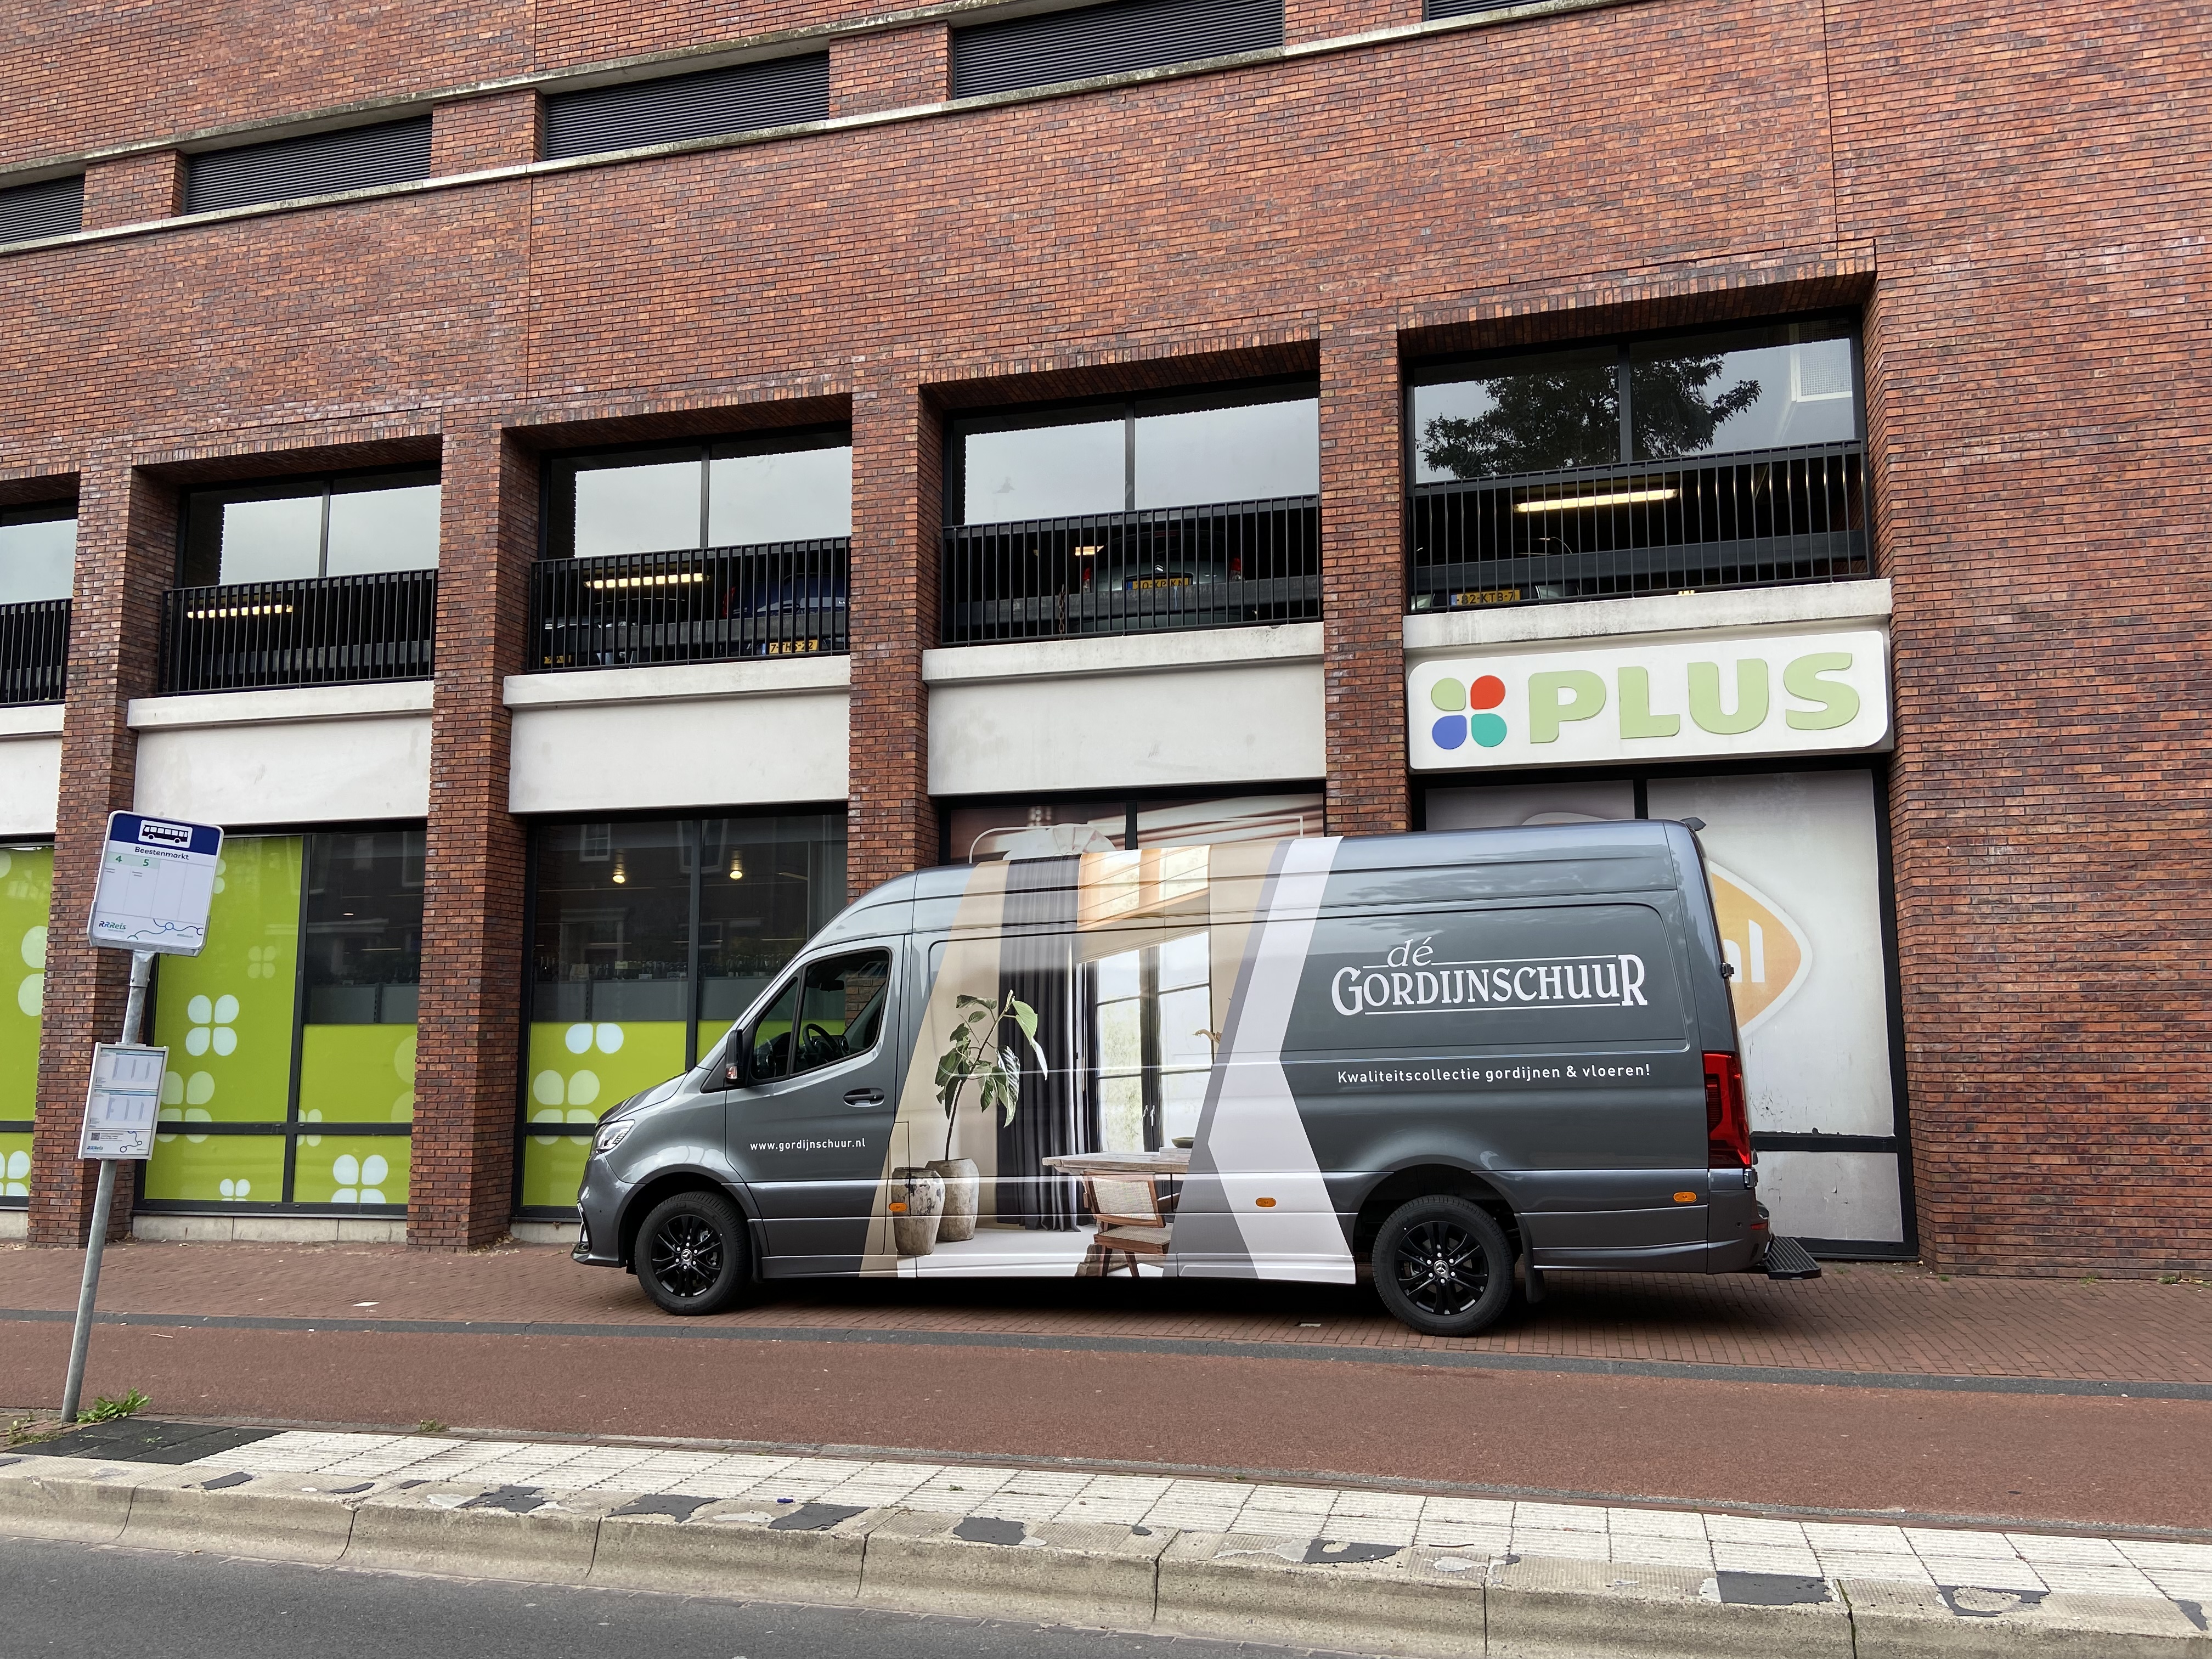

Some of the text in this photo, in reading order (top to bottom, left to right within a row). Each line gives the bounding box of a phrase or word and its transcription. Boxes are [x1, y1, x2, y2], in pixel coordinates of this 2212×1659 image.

[1528, 652, 1860, 743] PLUS
[135, 847, 189, 860] Beestenmarkt
[99, 921, 127, 930] RRReis
[1387, 937, 1434, 967] dé
[1331, 954, 1648, 1016] GORDIJNSCHUUR
[1338, 1063, 1651, 1083] Kwaliteitscollectie gordijnen & vloeren!
[750, 1138, 866, 1152] www.gordijnschuur.nl
